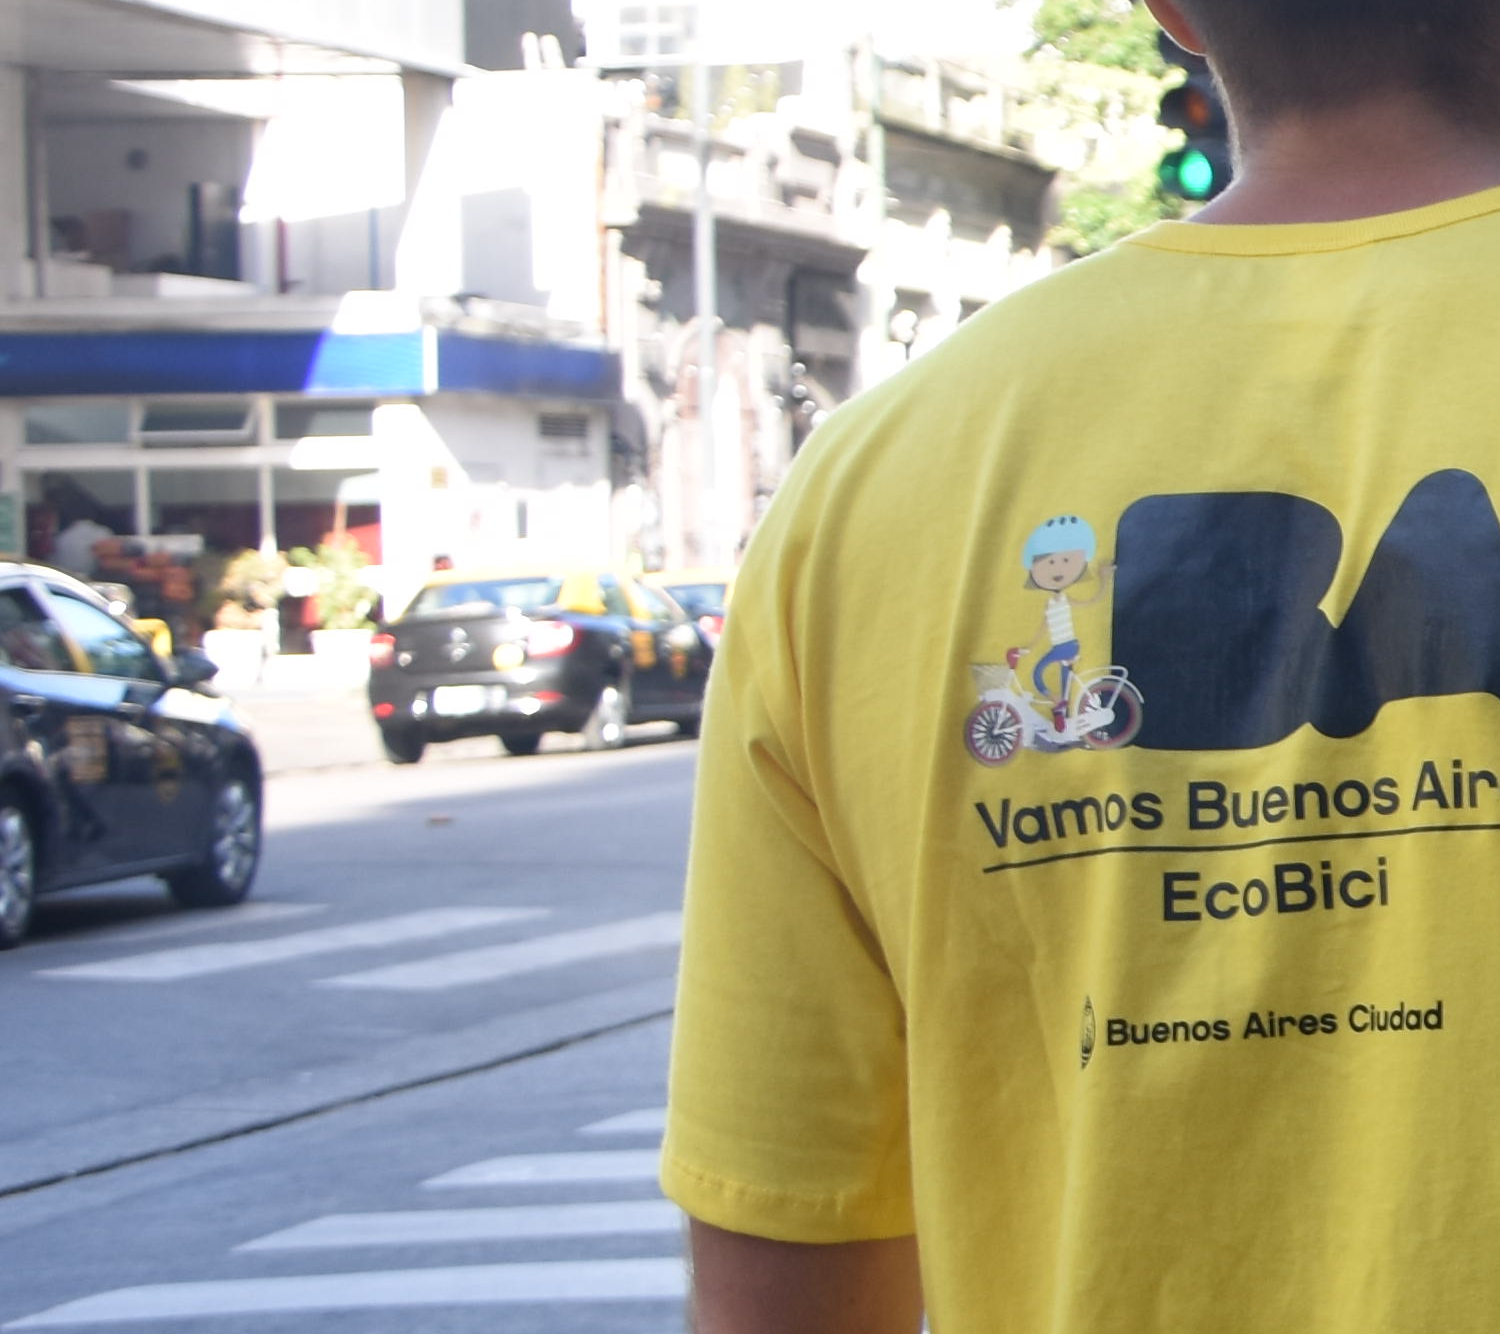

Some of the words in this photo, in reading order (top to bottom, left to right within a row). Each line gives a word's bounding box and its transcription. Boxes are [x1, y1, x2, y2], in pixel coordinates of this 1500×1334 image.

[975, 789, 1164, 849] Vamos
[1186, 777, 1400, 831] Buenos
[1162, 857, 1389, 922] EcoBici
[1106, 1014, 1230, 1047] Buenos
[1244, 1008, 1338, 1040] Aires
[1348, 1000, 1443, 1033] Ciudad
